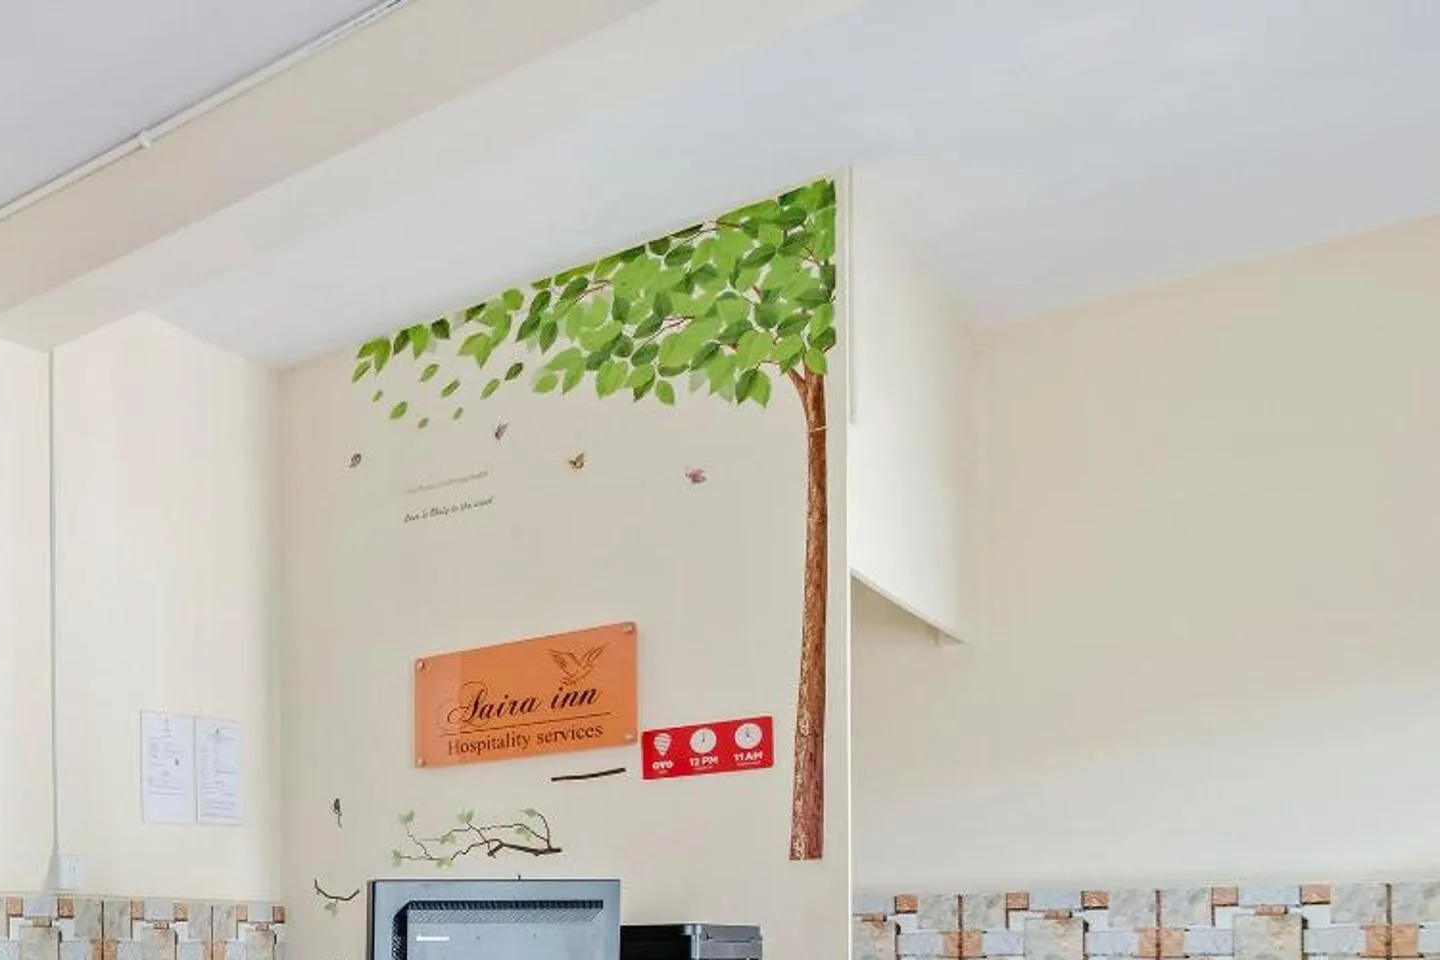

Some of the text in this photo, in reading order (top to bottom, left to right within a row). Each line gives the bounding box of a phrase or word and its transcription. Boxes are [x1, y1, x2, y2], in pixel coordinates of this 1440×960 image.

[550, 686, 603, 710] inn
[448, 724, 604, 756] Hospitality services
[689, 755, 719, 767] 12 PM
[733, 750, 764, 762] 11 AM
